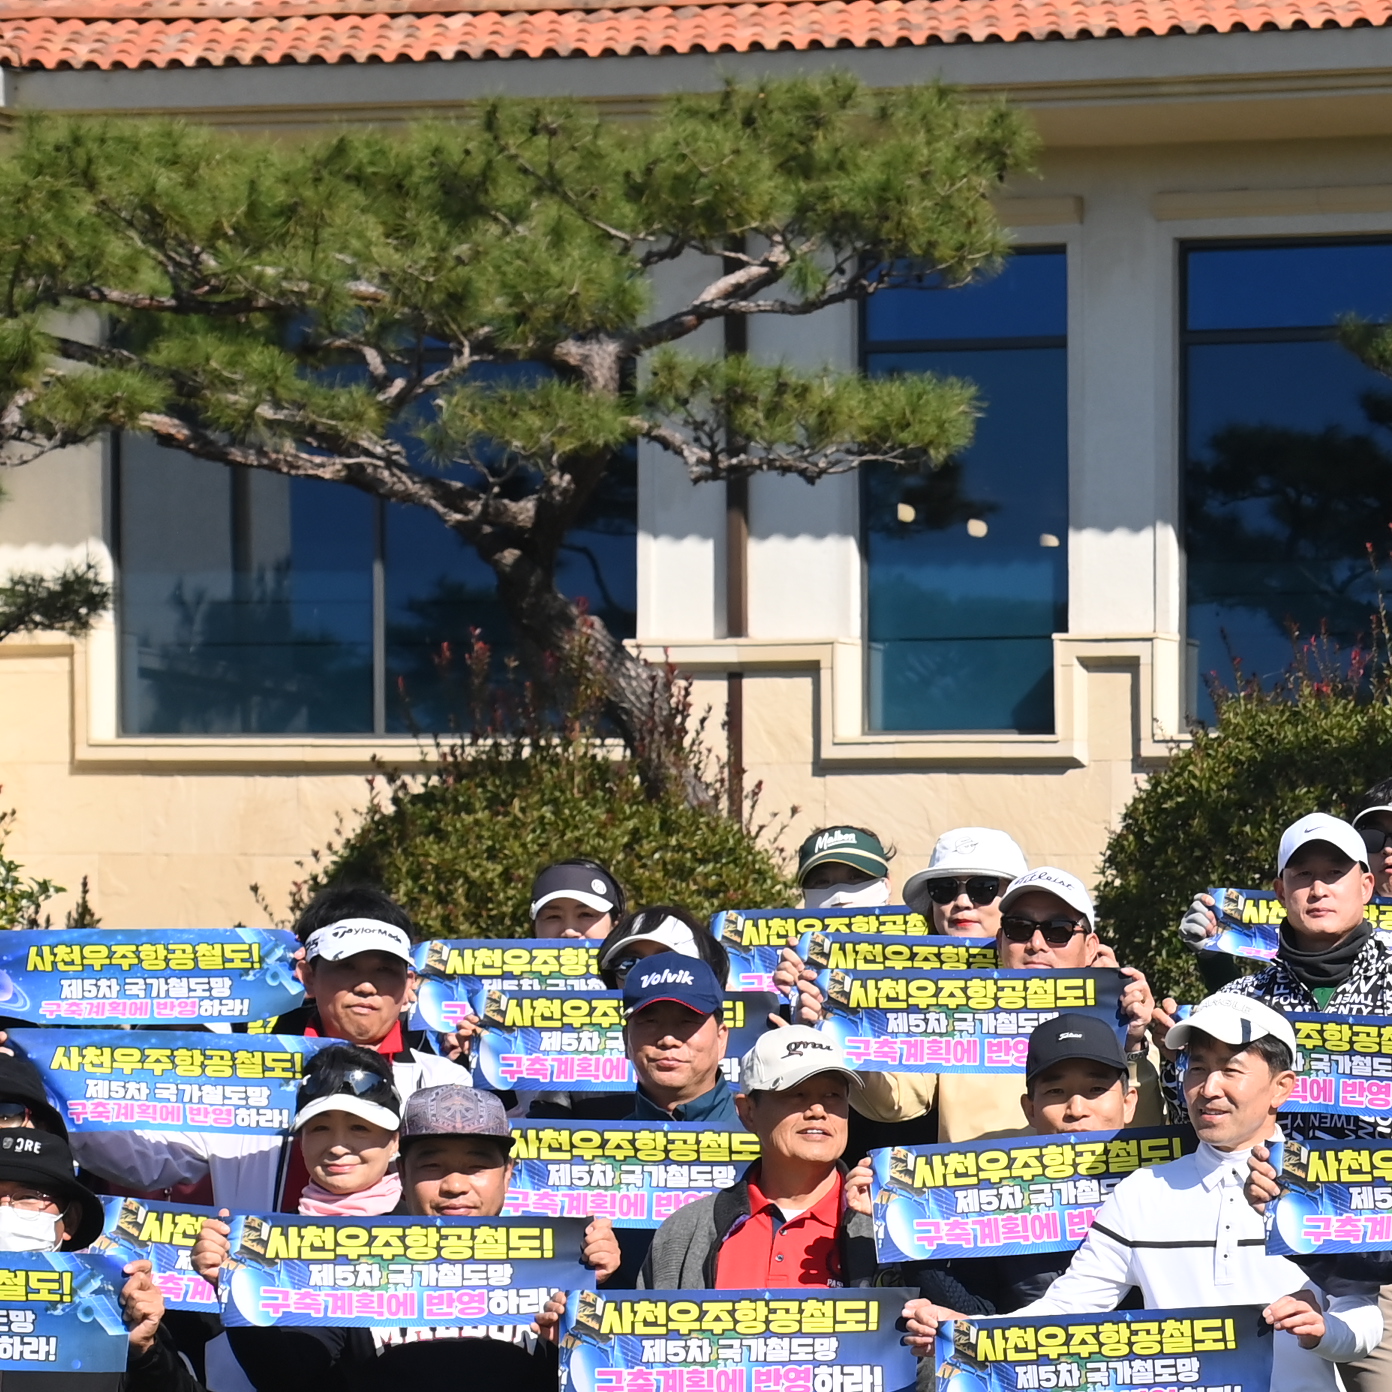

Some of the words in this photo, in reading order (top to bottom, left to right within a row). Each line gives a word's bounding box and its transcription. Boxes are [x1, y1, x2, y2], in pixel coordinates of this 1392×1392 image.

[814, 829, 858, 854] Malbon
[26, 944, 260, 972] 사천우주항공철도!
[61, 977, 119, 999] 제5차
[124, 977, 231, 999] 국가철도망
[640, 969, 694, 988] Volvik
[849, 978, 1095, 1010] 사천우주항공철도!
[39, 999, 150, 1018] 구축계획에
[887, 1012, 947, 1034] 제5차
[540, 1031, 600, 1052] 제5차
[843, 1037, 979, 1064] 구축계획에
[50, 1046, 303, 1079] 사천우주항공철도!
[500, 1054, 627, 1082] 구축계획에
[85, 1079, 148, 1101] 제5차
[154, 1082, 270, 1106] 국가철도망
[67, 1101, 182, 1125] 구축계획에
[512, 1129, 760, 1161] 사천우주항공철도
[547, 1164, 614, 1187] 제5차
[620, 1164, 735, 1187] 국가철도망
[503, 1189, 646, 1219] 구축계획에
[955, 1188, 1023, 1213] 제5차
[265, 1226, 553, 1261] 사천우주항공철도!
[915, 1213, 1058, 1249] 구축계획에
[308, 1264, 381, 1287] 제5차
[388, 1263, 513, 1287] 국가철도망
[259, 1288, 417, 1318] 구축계획에
[600, 1299, 878, 1334] 사천우주항공철도!
[641, 1338, 711, 1363] 제5차
[717, 1336, 838, 1361] 국가철도망
[976, 1319, 1235, 1362] 사천우주항공철도!
[1016, 1363, 1080, 1389] 제5차
[1085, 1358, 1200, 1385] 국가철도망
